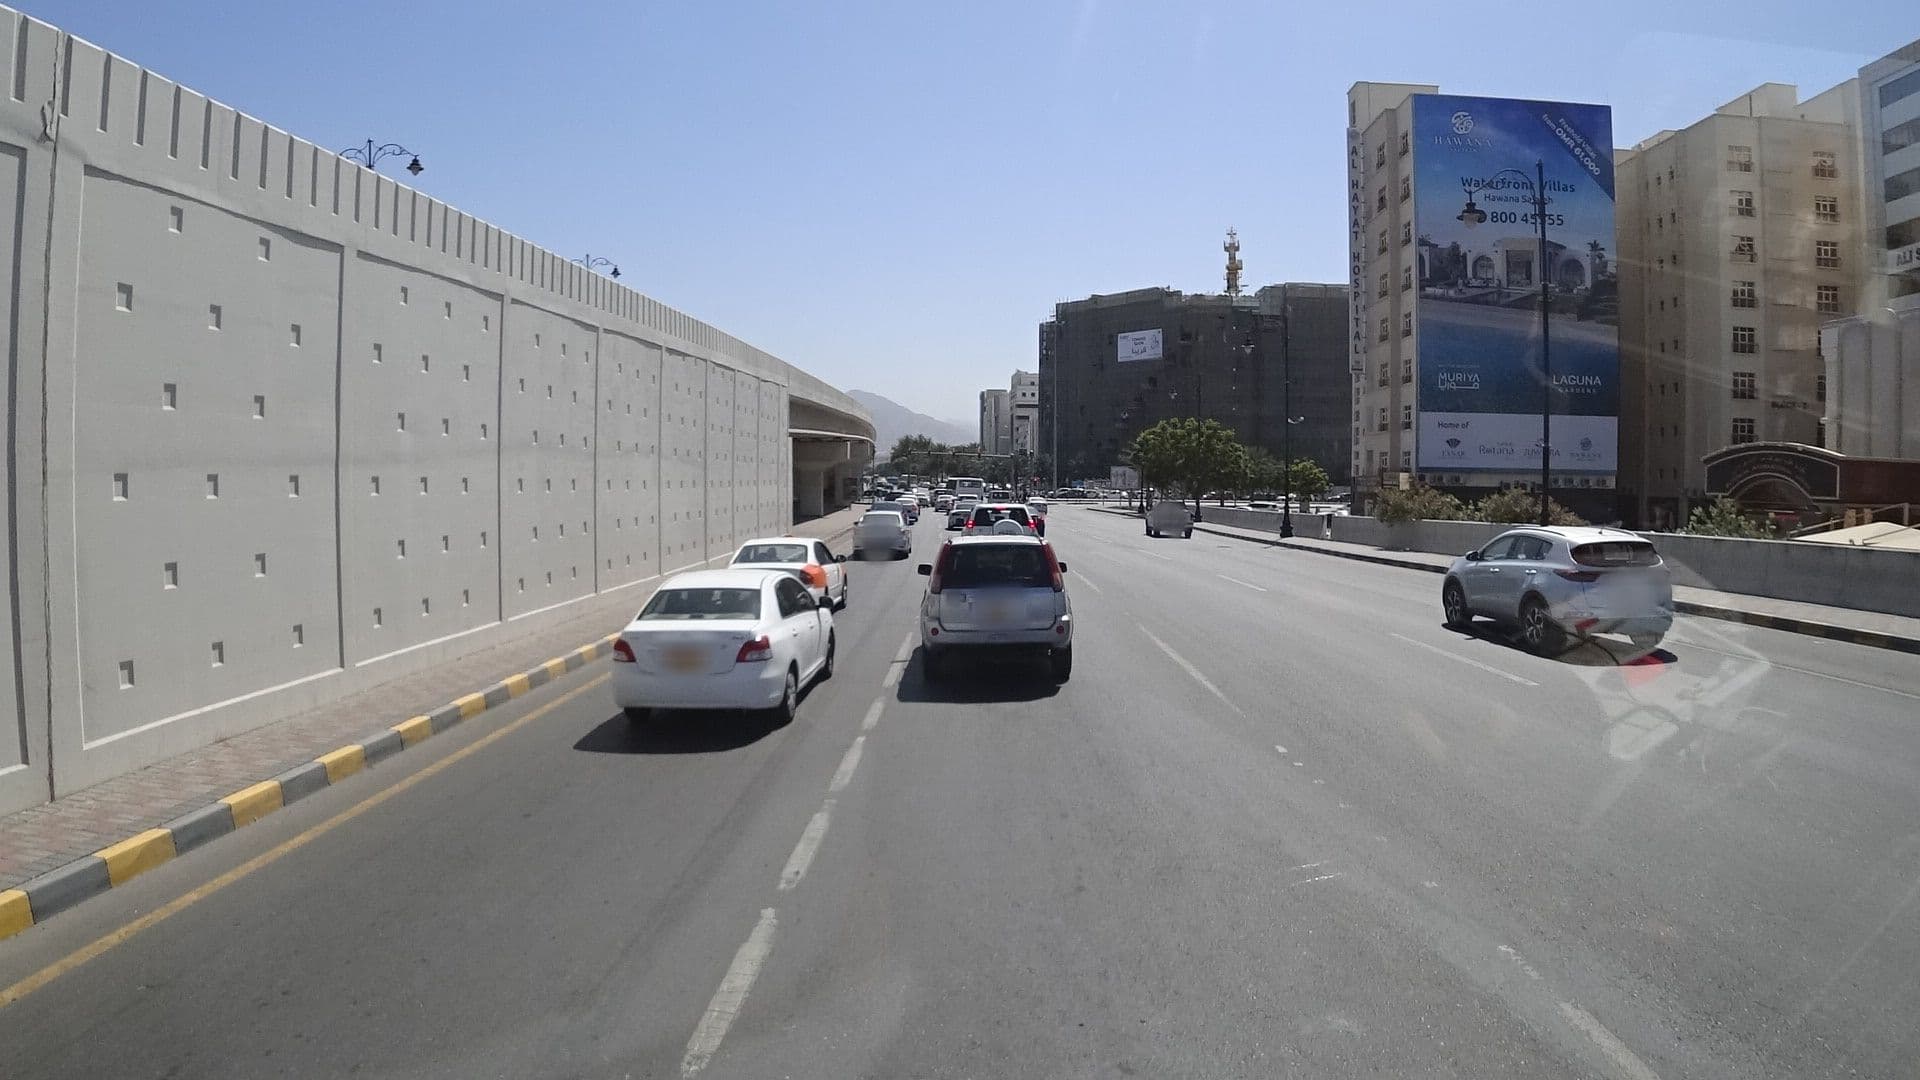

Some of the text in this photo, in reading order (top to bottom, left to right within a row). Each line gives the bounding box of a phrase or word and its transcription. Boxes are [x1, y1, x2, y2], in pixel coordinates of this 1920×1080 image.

[1555, 127, 1575, 149] OMR
[1484, 193, 1520, 203] Hawana
[1490, 210, 1517, 223] 800
[1351, 145, 1361, 354] AL HAYAT HOSPITAL
[1439, 371, 1480, 382] MURIYA
[1552, 374, 1602, 386] LAGUNA
[1437, 421, 1470, 429] Home of
